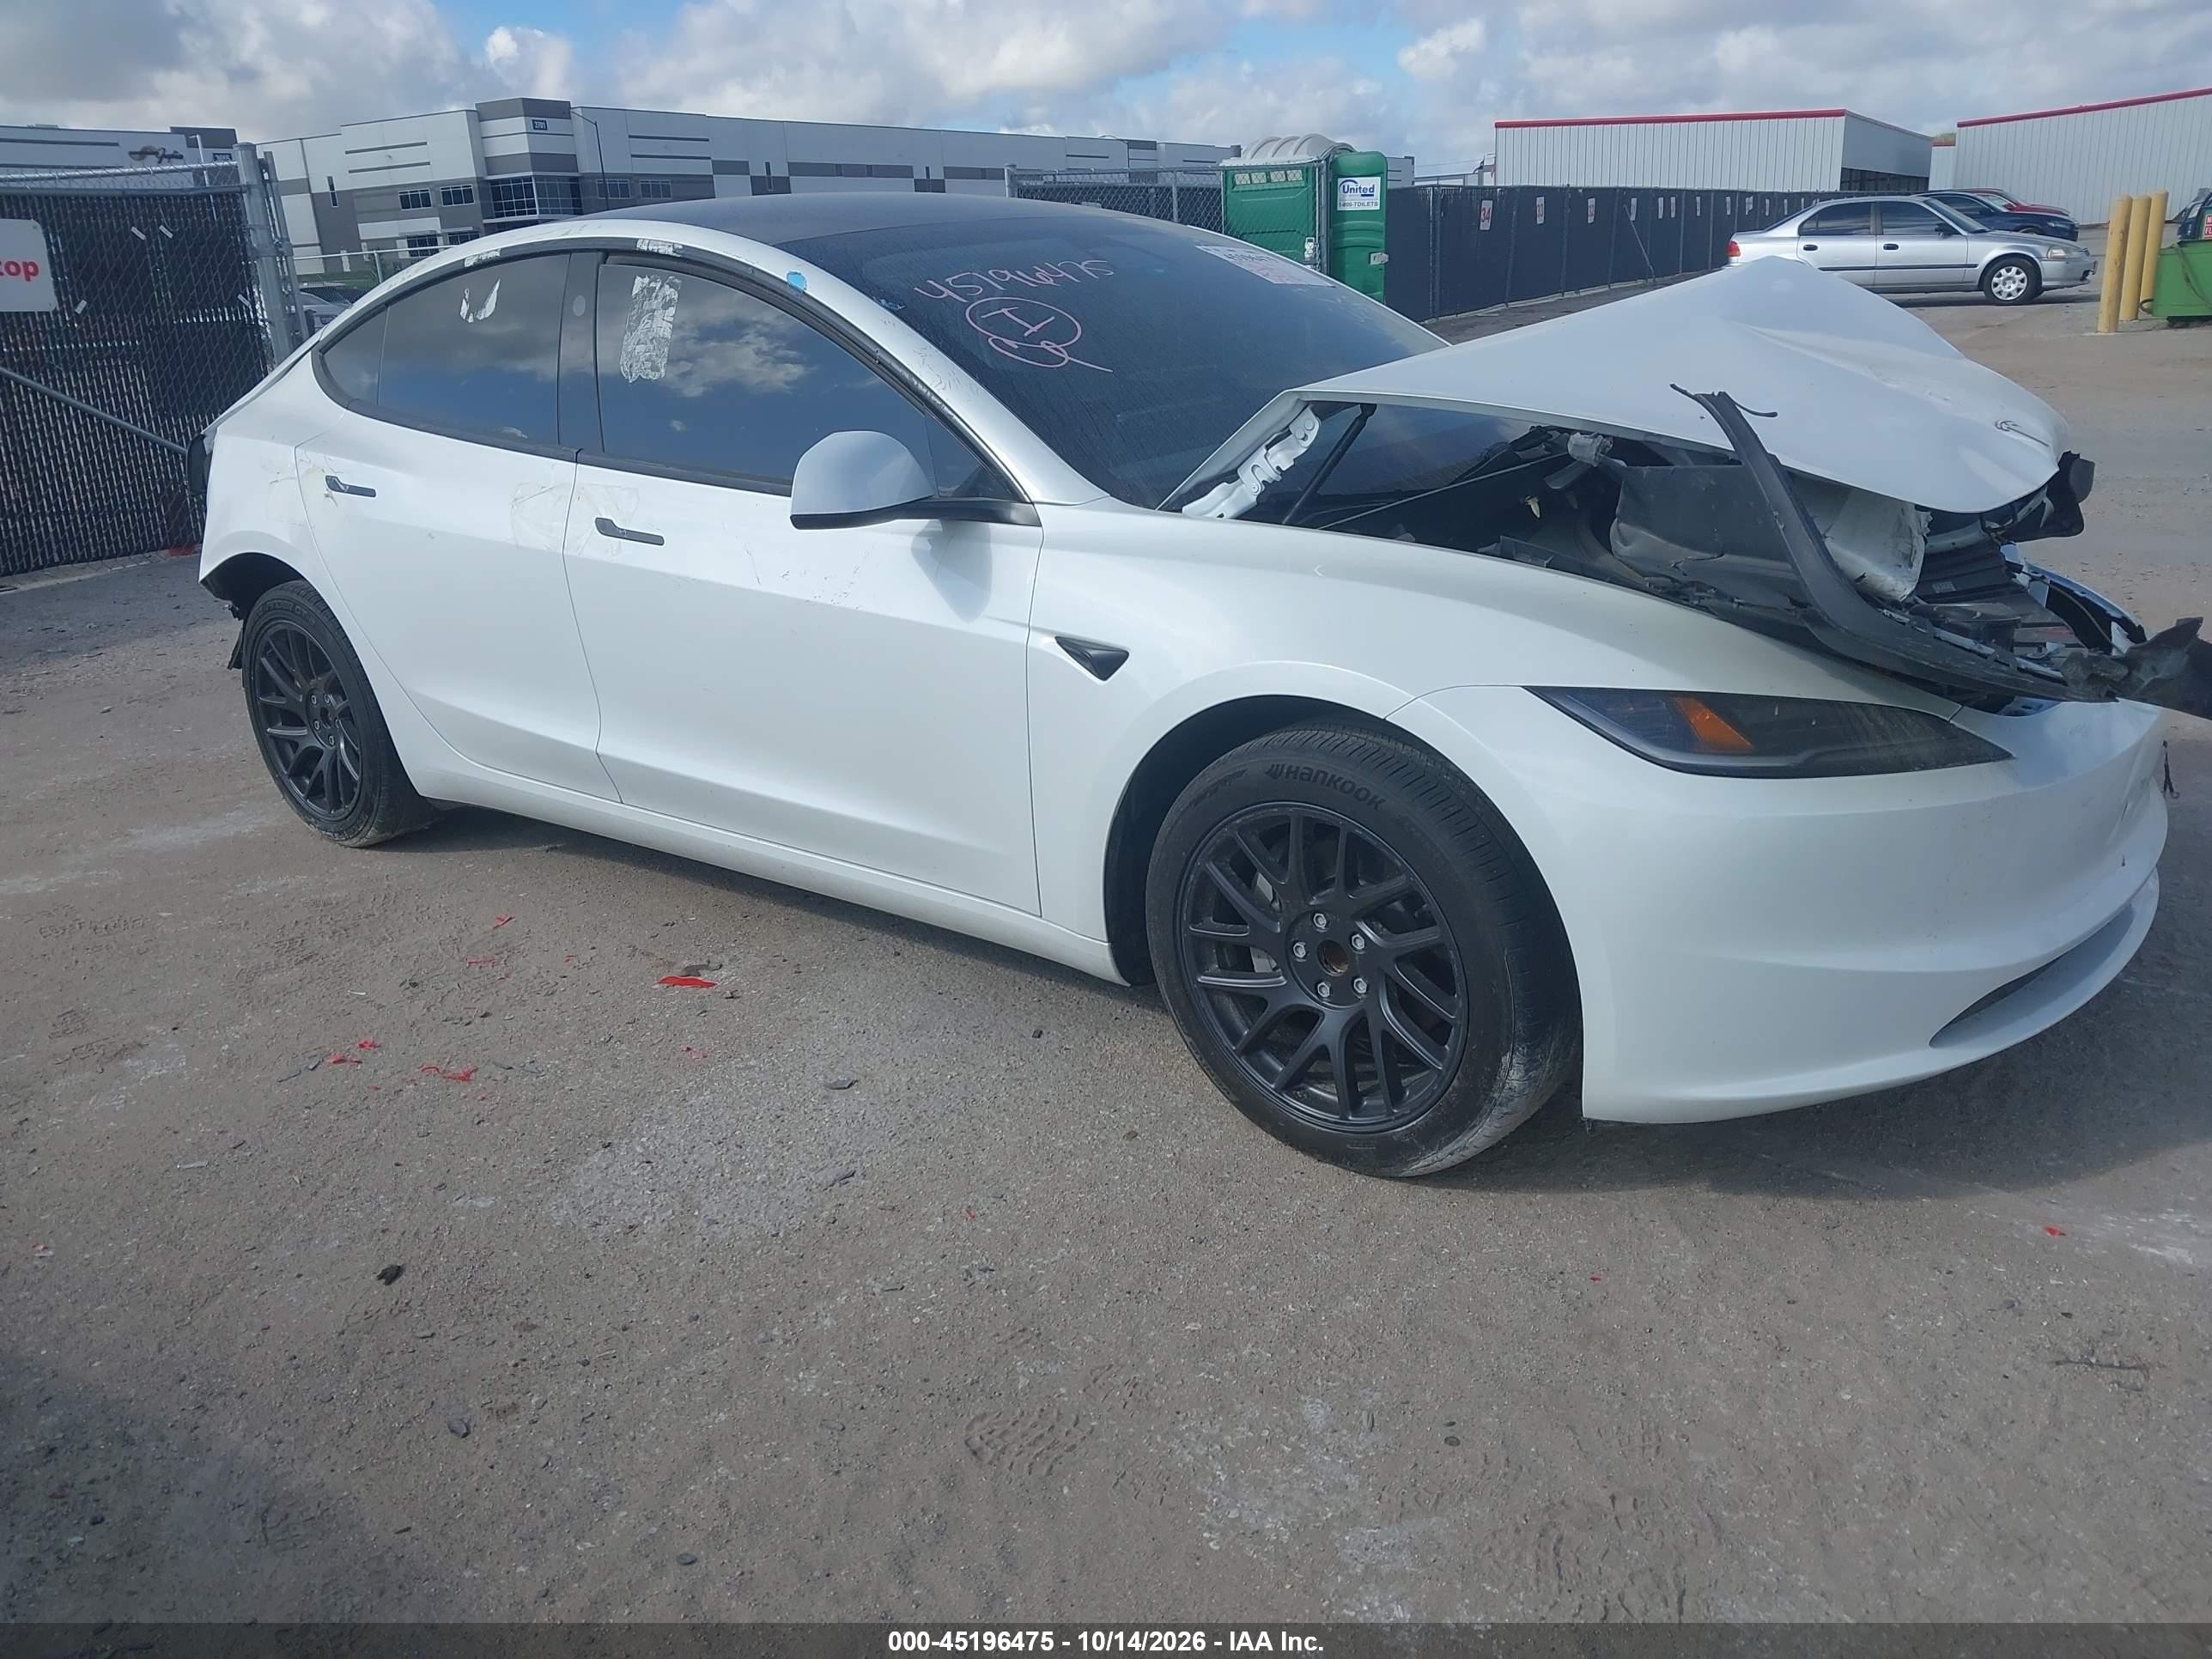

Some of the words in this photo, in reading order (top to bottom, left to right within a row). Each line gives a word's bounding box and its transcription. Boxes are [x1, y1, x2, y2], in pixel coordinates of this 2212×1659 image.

[1342, 184, 1375, 194] United
[1480, 206, 1492, 223] 34
[914, 259, 1115, 302] 45196475
